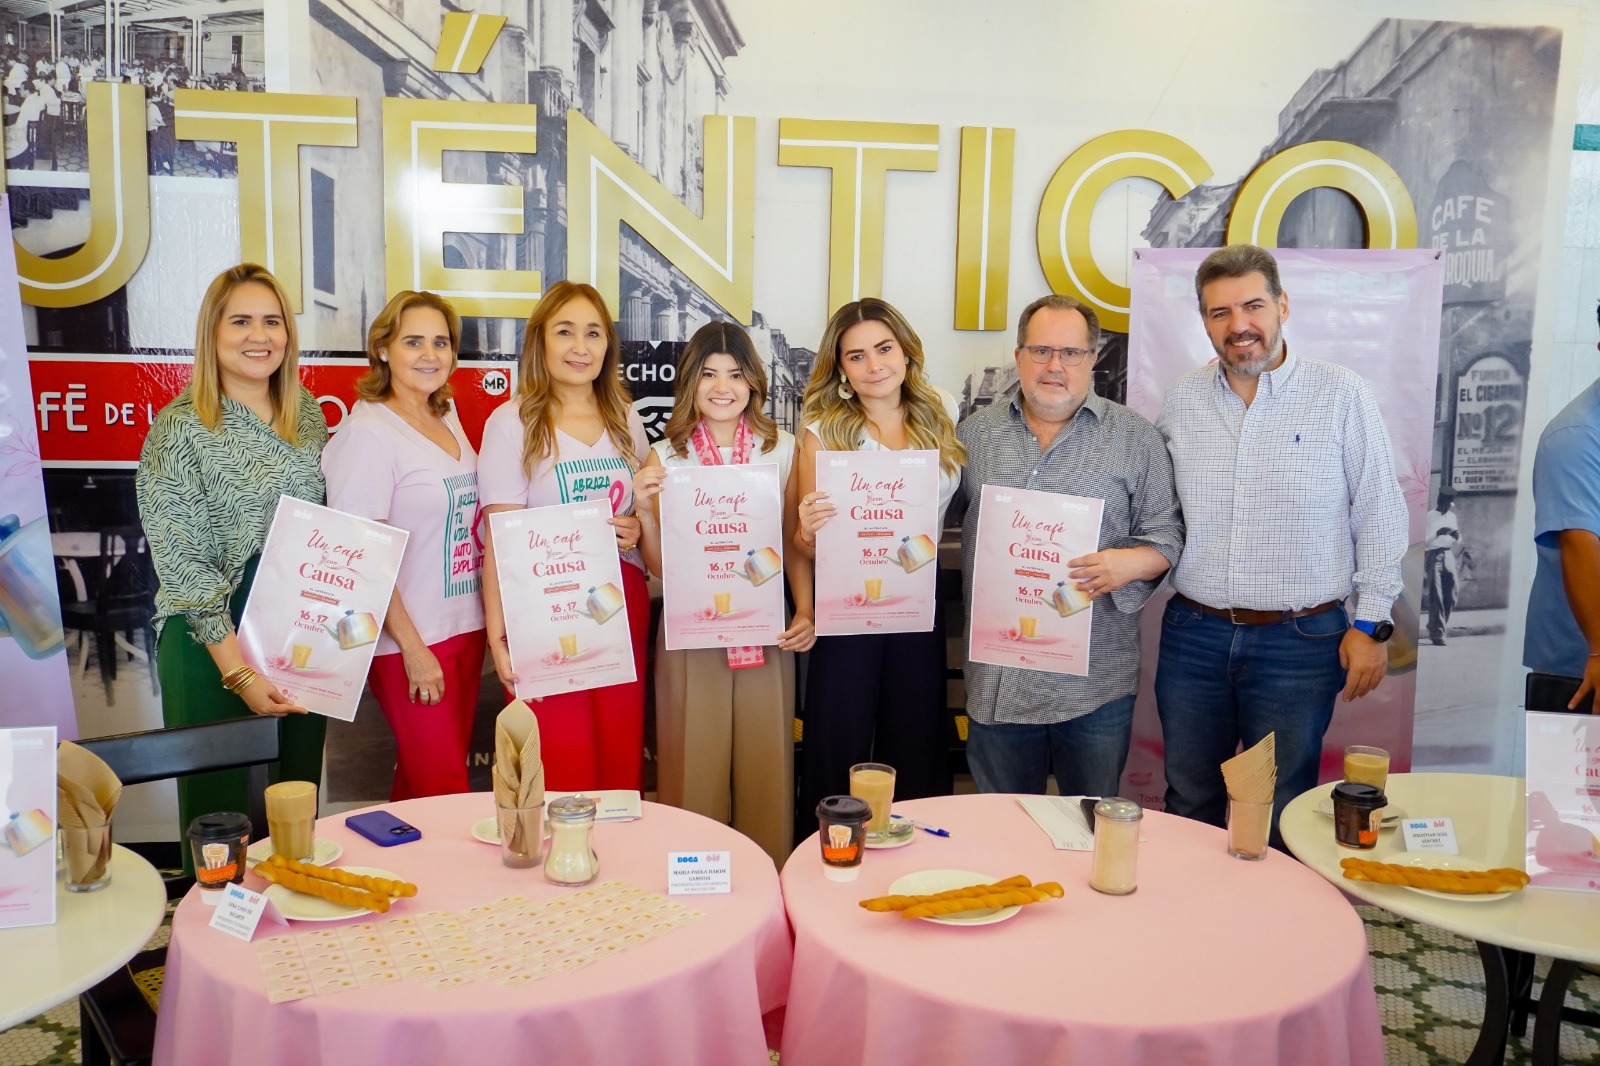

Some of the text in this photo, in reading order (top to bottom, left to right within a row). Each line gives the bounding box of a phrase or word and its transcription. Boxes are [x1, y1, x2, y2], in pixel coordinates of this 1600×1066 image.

[1432, 195, 1495, 231] CAFE
[1432, 227, 1486, 250] DE LA
[484, 377, 507, 390] MR
[1459, 388, 1473, 402] EL
[104, 402, 135, 425] DE
[572, 475, 611, 494] ABRAZA
[850, 472, 906, 499] Un café
[694, 487, 749, 513] Un café
[454, 511, 464, 525] TU
[850, 505, 904, 521] Causa
[453, 526, 469, 542] VIDA
[695, 520, 749, 536] Causa
[1011, 509, 1066, 541] Un café
[306, 528, 365, 566] Un café
[528, 529, 583, 552] Un café
[453, 542, 472, 559] AUTO
[1008, 542, 1061, 564] Causa
[299, 562, 355, 591] Causa
[532, 559, 587, 578] Causa
[707, 572, 736, 580] Octubre
[1015, 597, 1044, 606] Octubre
[294, 620, 326, 634] Octubre
[550, 613, 580, 622] Octubre
